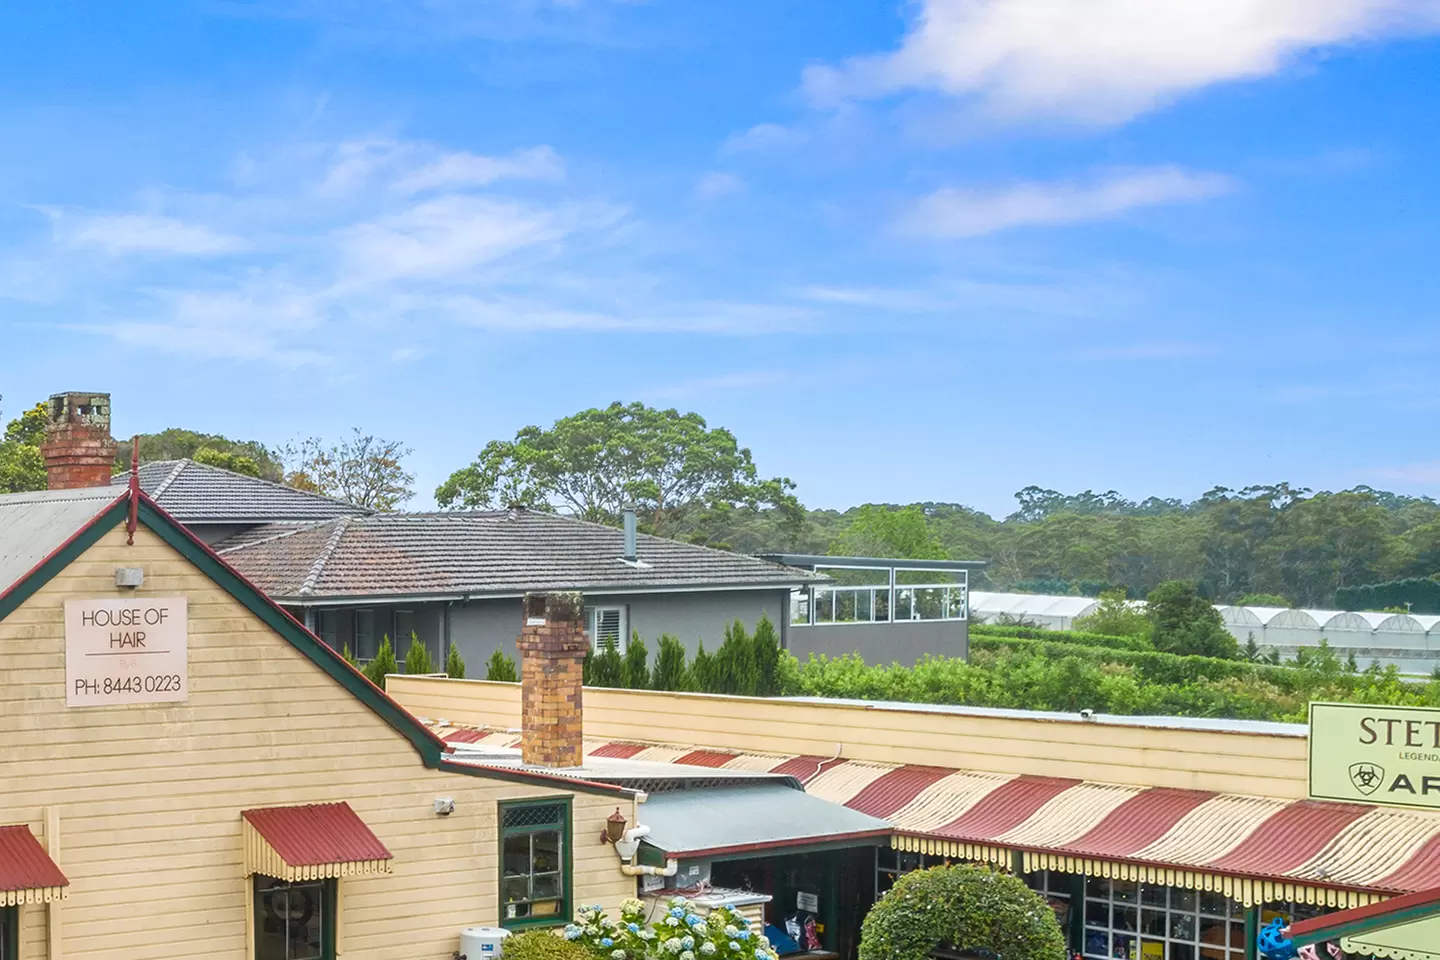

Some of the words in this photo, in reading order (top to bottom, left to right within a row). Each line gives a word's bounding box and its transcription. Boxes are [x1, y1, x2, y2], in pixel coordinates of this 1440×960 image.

[82, 609, 141, 626] HOUSE
[144, 608, 169, 625] OF
[109, 631, 147, 648] HAIR
[75, 679, 100, 695] PH:
[103, 676, 142, 695] 8443
[144, 675, 181, 693] 0223
[1359, 717, 1440, 748] STET
[1399, 751, 1440, 762] LEGEND
